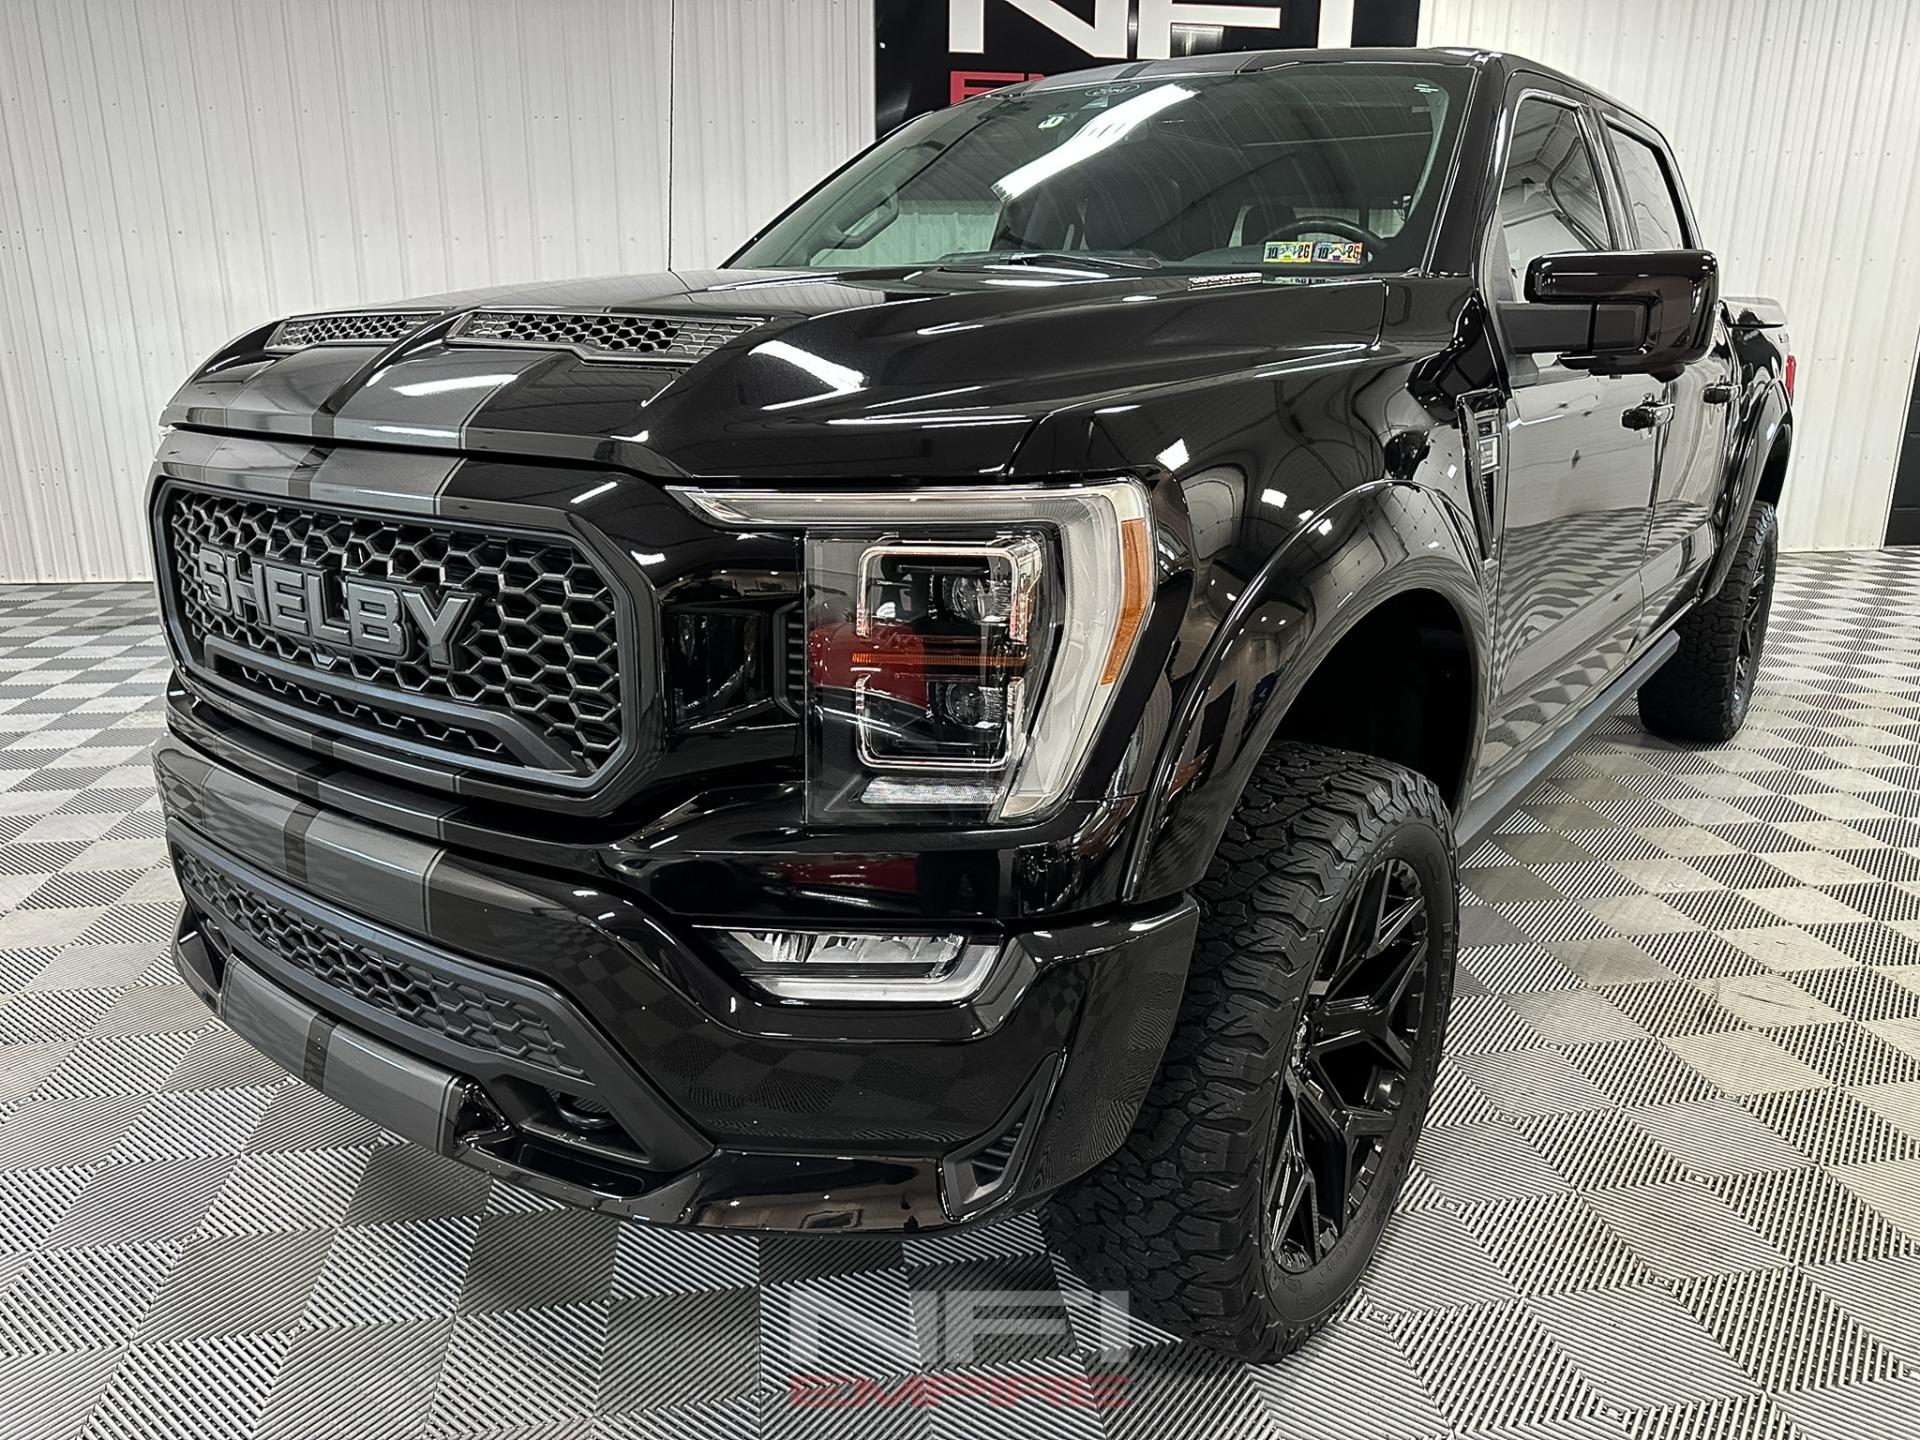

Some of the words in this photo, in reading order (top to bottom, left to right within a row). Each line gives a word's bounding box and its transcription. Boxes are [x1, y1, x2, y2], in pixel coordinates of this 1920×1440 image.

[948, 0, 1353, 59] NFI
[1297, 244, 1310, 259] 26
[1347, 244, 1361, 260] 26
[199, 548, 475, 667] SHELBY
